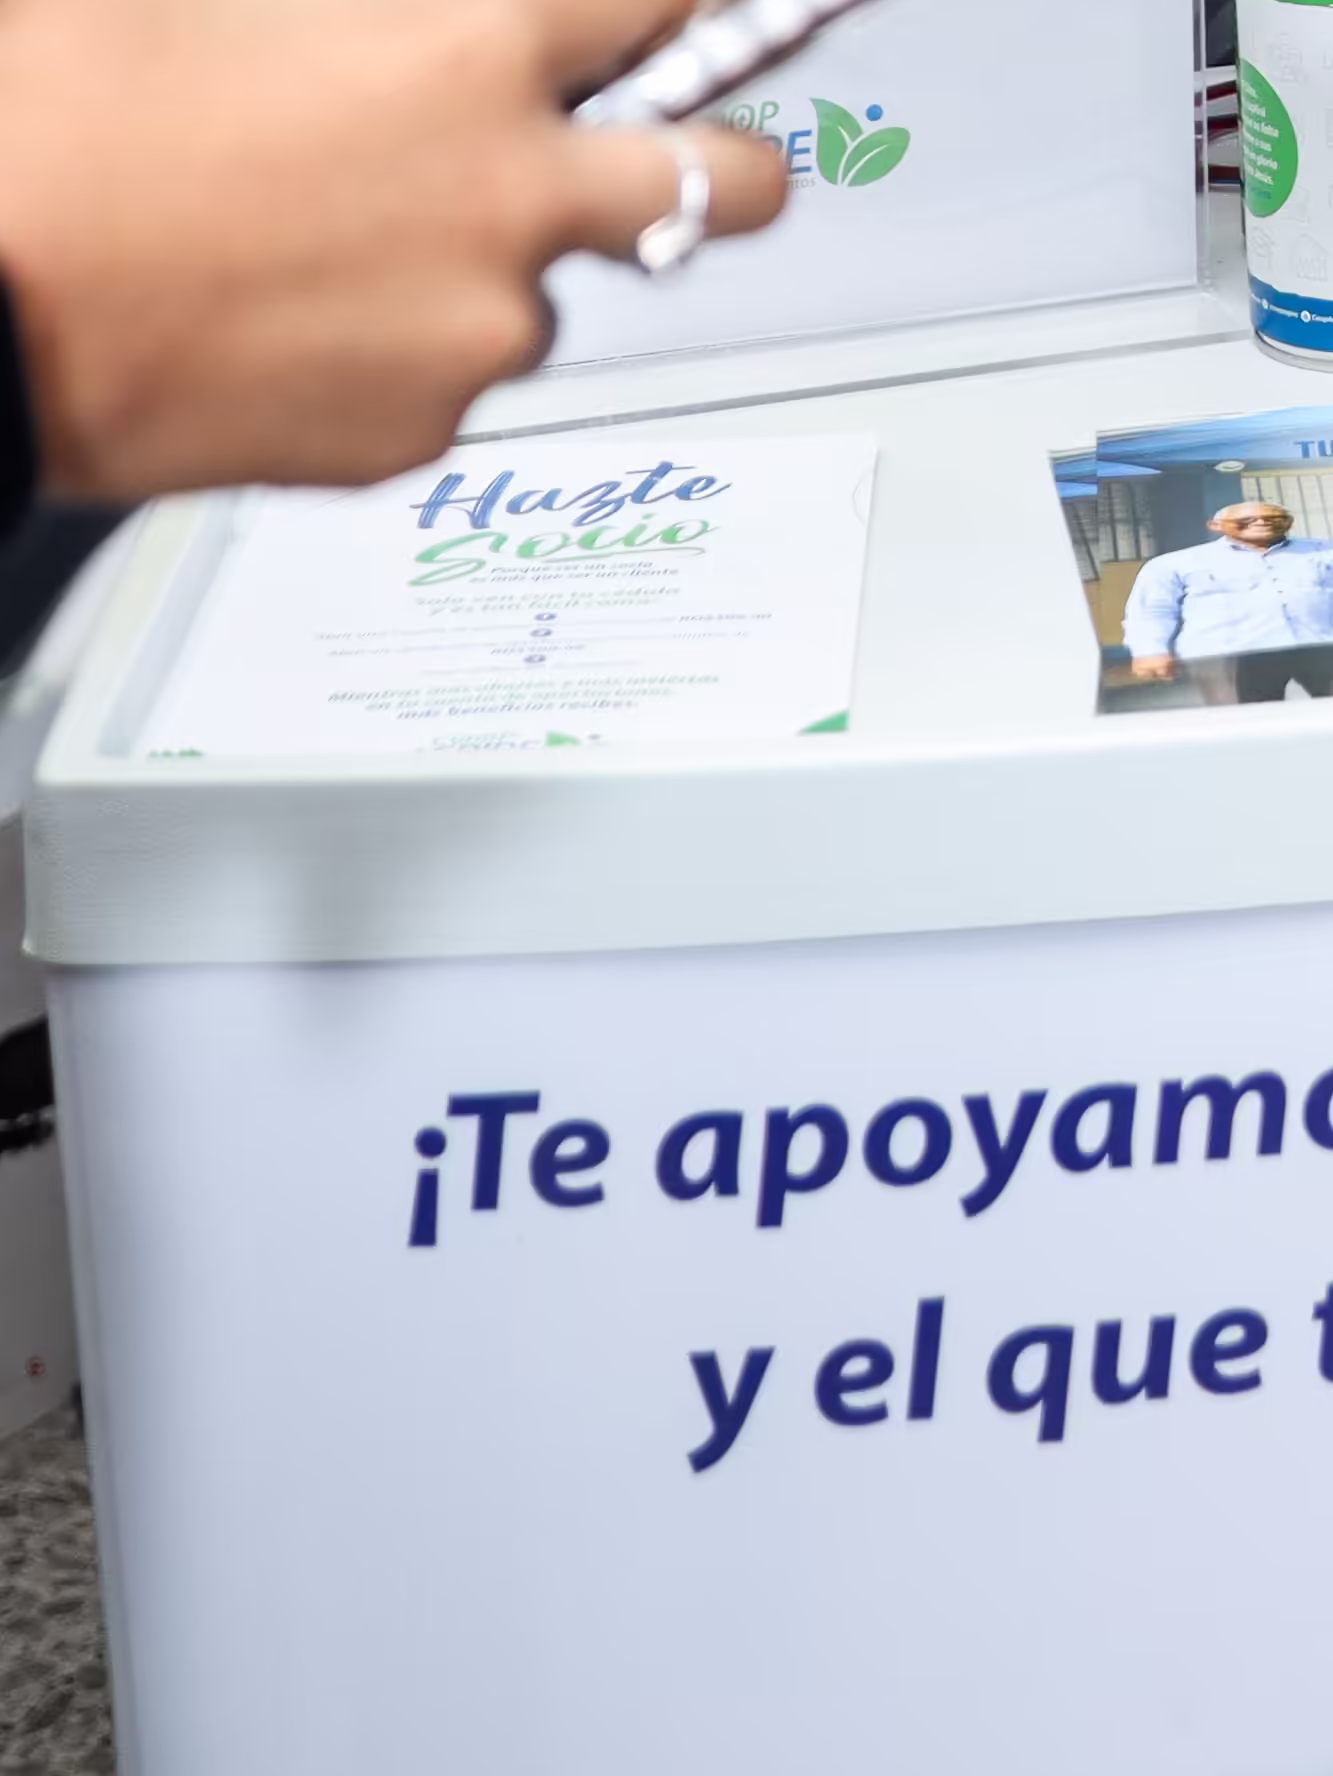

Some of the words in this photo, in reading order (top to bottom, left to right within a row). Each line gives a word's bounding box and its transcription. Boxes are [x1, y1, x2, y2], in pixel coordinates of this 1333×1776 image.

[406, 512, 723, 587] Socio
[409, 460, 733, 530] Hazte
[408, 1088, 611, 1248] ¡Te
[687, 1343, 776, 1474] y
[813, 1295, 945, 1428] el
[985, 1304, 1271, 1443] que
